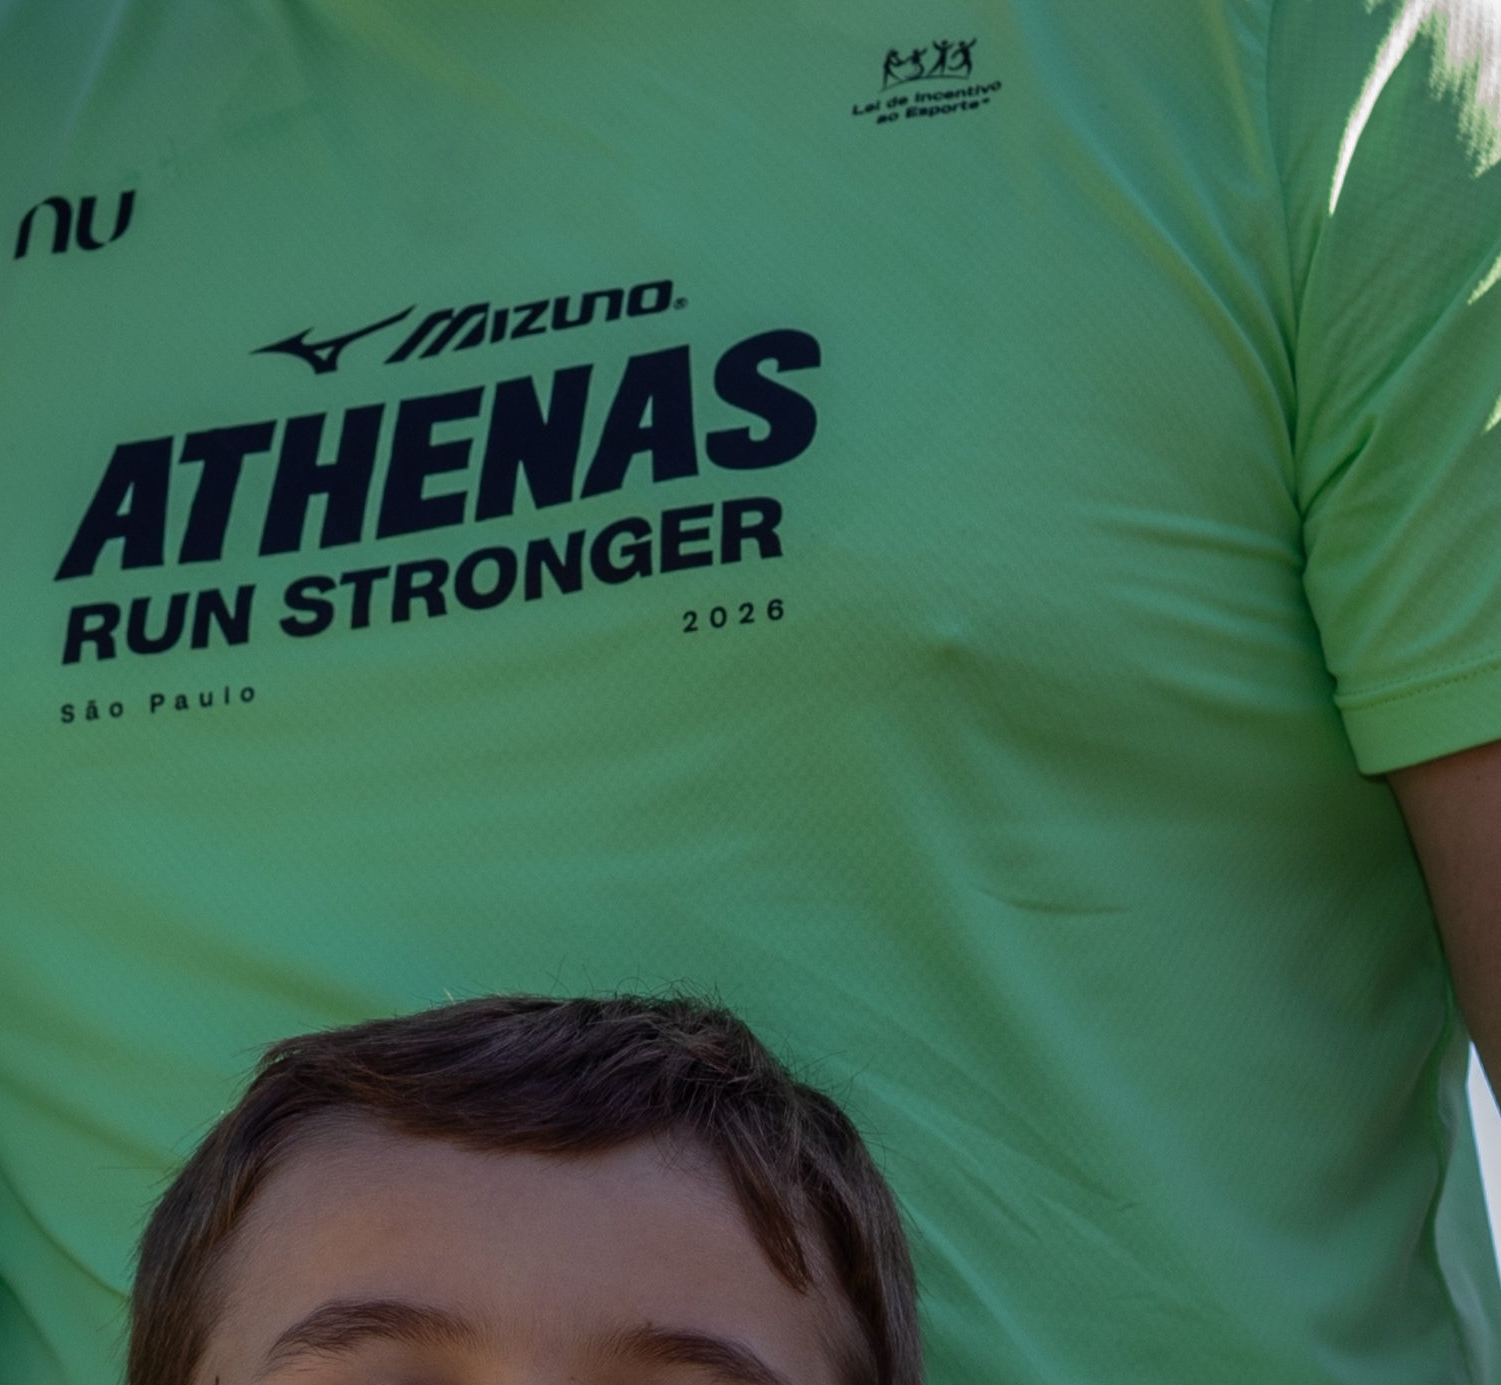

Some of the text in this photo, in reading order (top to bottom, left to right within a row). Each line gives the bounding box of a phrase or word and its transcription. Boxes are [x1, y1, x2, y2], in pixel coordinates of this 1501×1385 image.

[53, 327, 822, 581] ATHENAS
[61, 495, 783, 665] RUN STRONGER
[682, 598, 785, 634] 2026
[60, 685, 256, 724] São Paulo
